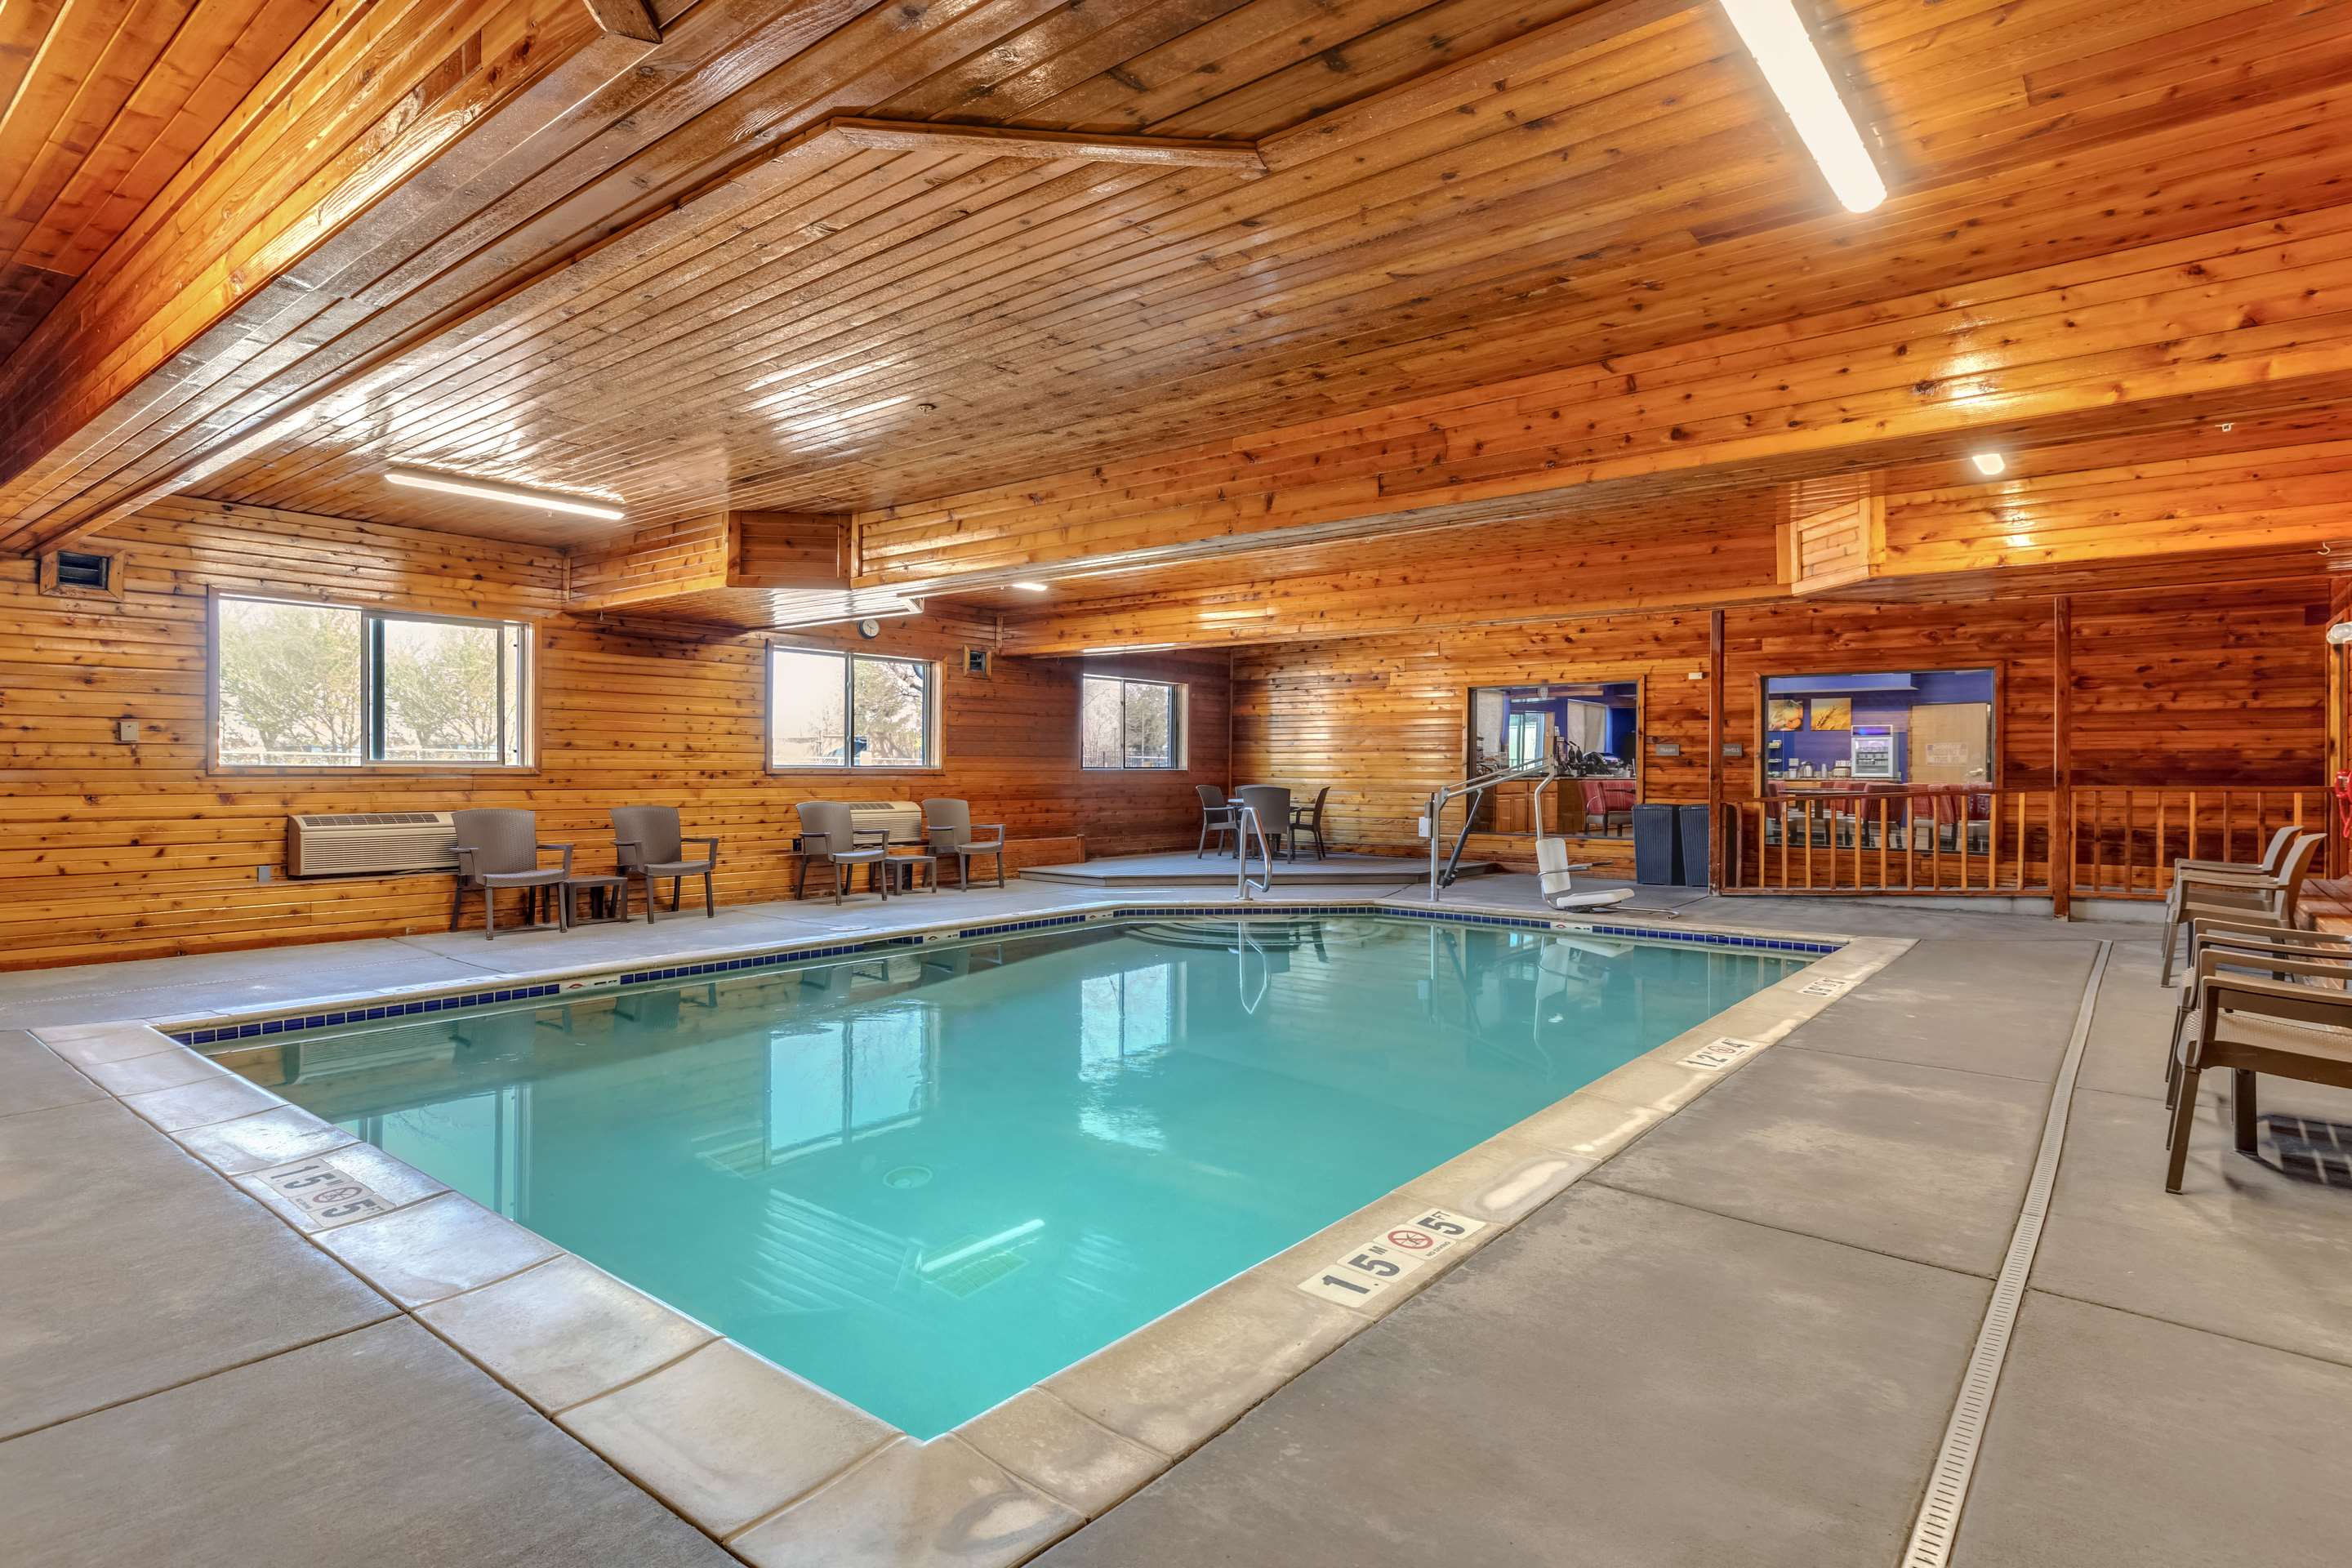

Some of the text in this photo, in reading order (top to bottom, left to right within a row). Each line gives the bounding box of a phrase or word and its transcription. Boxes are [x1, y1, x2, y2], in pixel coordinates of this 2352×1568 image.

[321, 1198, 376, 1218] 5
[1431, 1211, 1451, 1221] FT
[1417, 1218, 1465, 1236] 5
